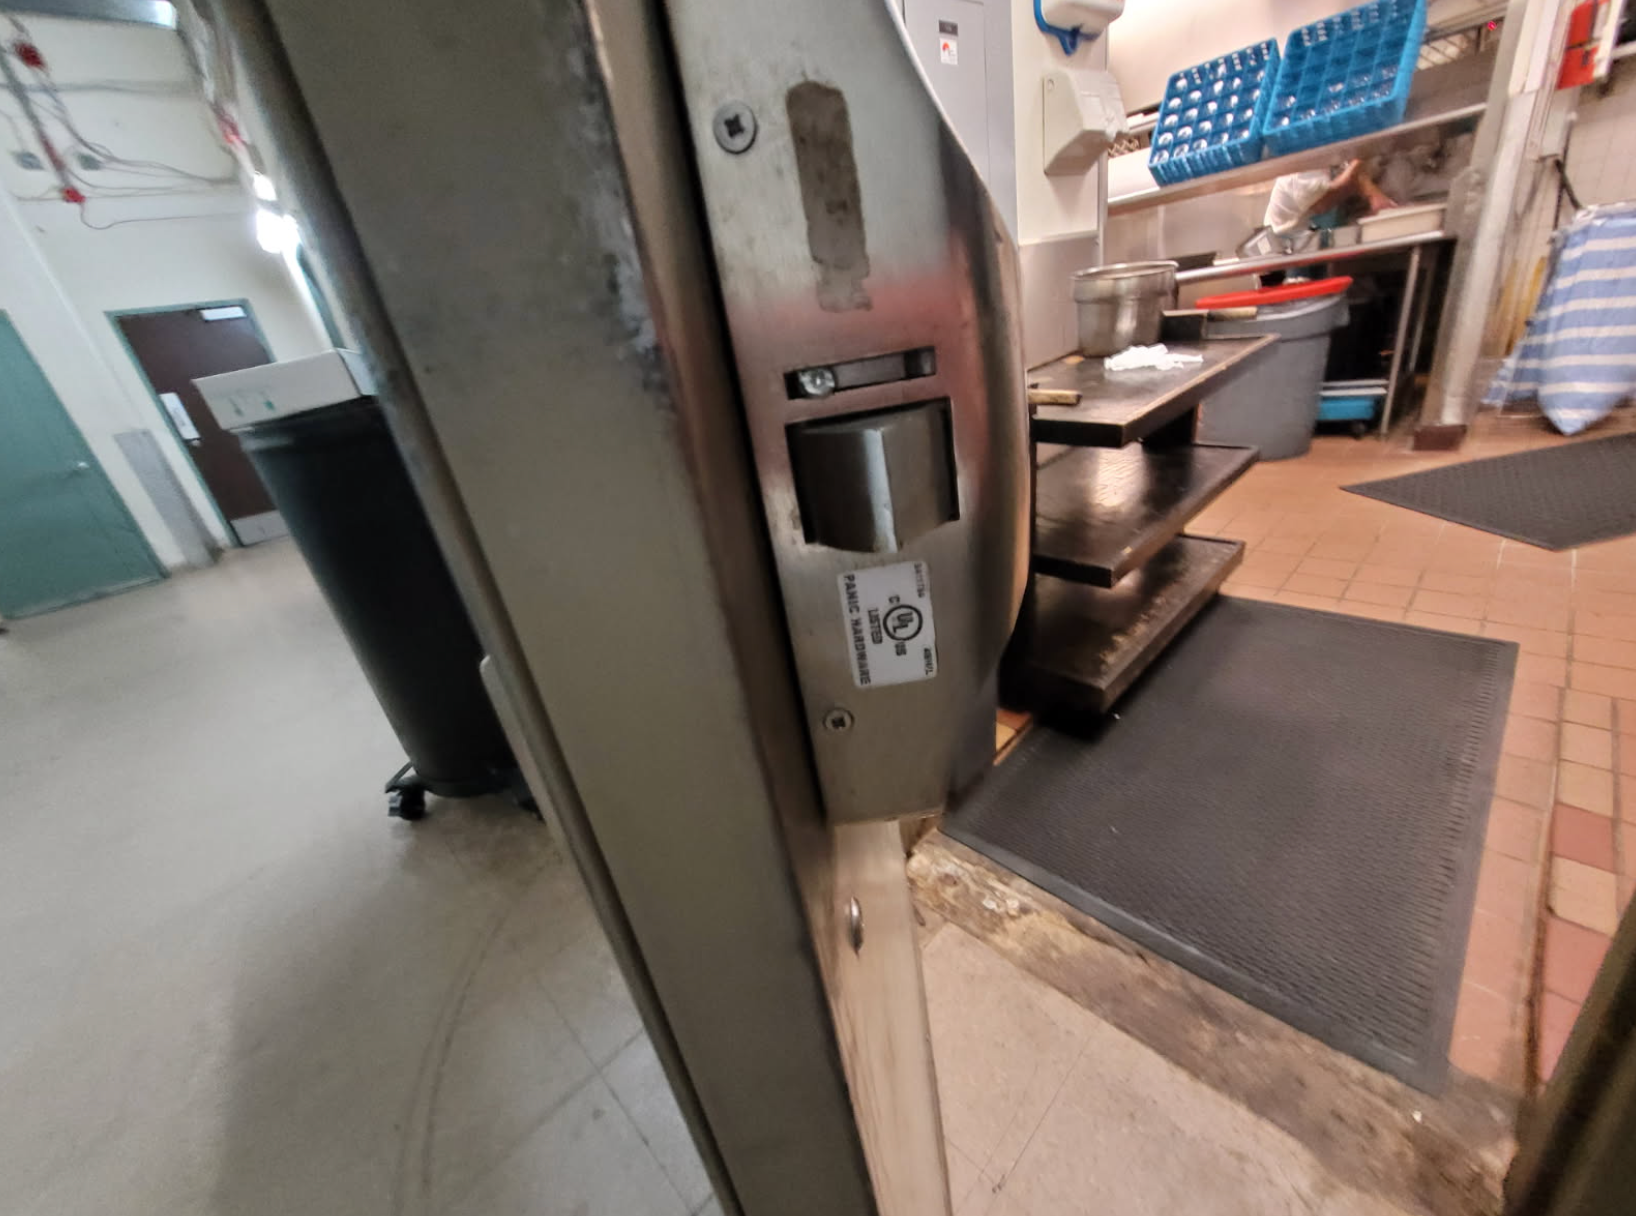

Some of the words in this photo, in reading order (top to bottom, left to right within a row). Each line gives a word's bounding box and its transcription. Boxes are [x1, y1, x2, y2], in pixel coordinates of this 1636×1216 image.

[843, 573, 860, 614] PANIC
[868, 607, 883, 645] LISTED
[892, 612, 914, 634] UL
[851, 616, 872, 685] HARDWARE
